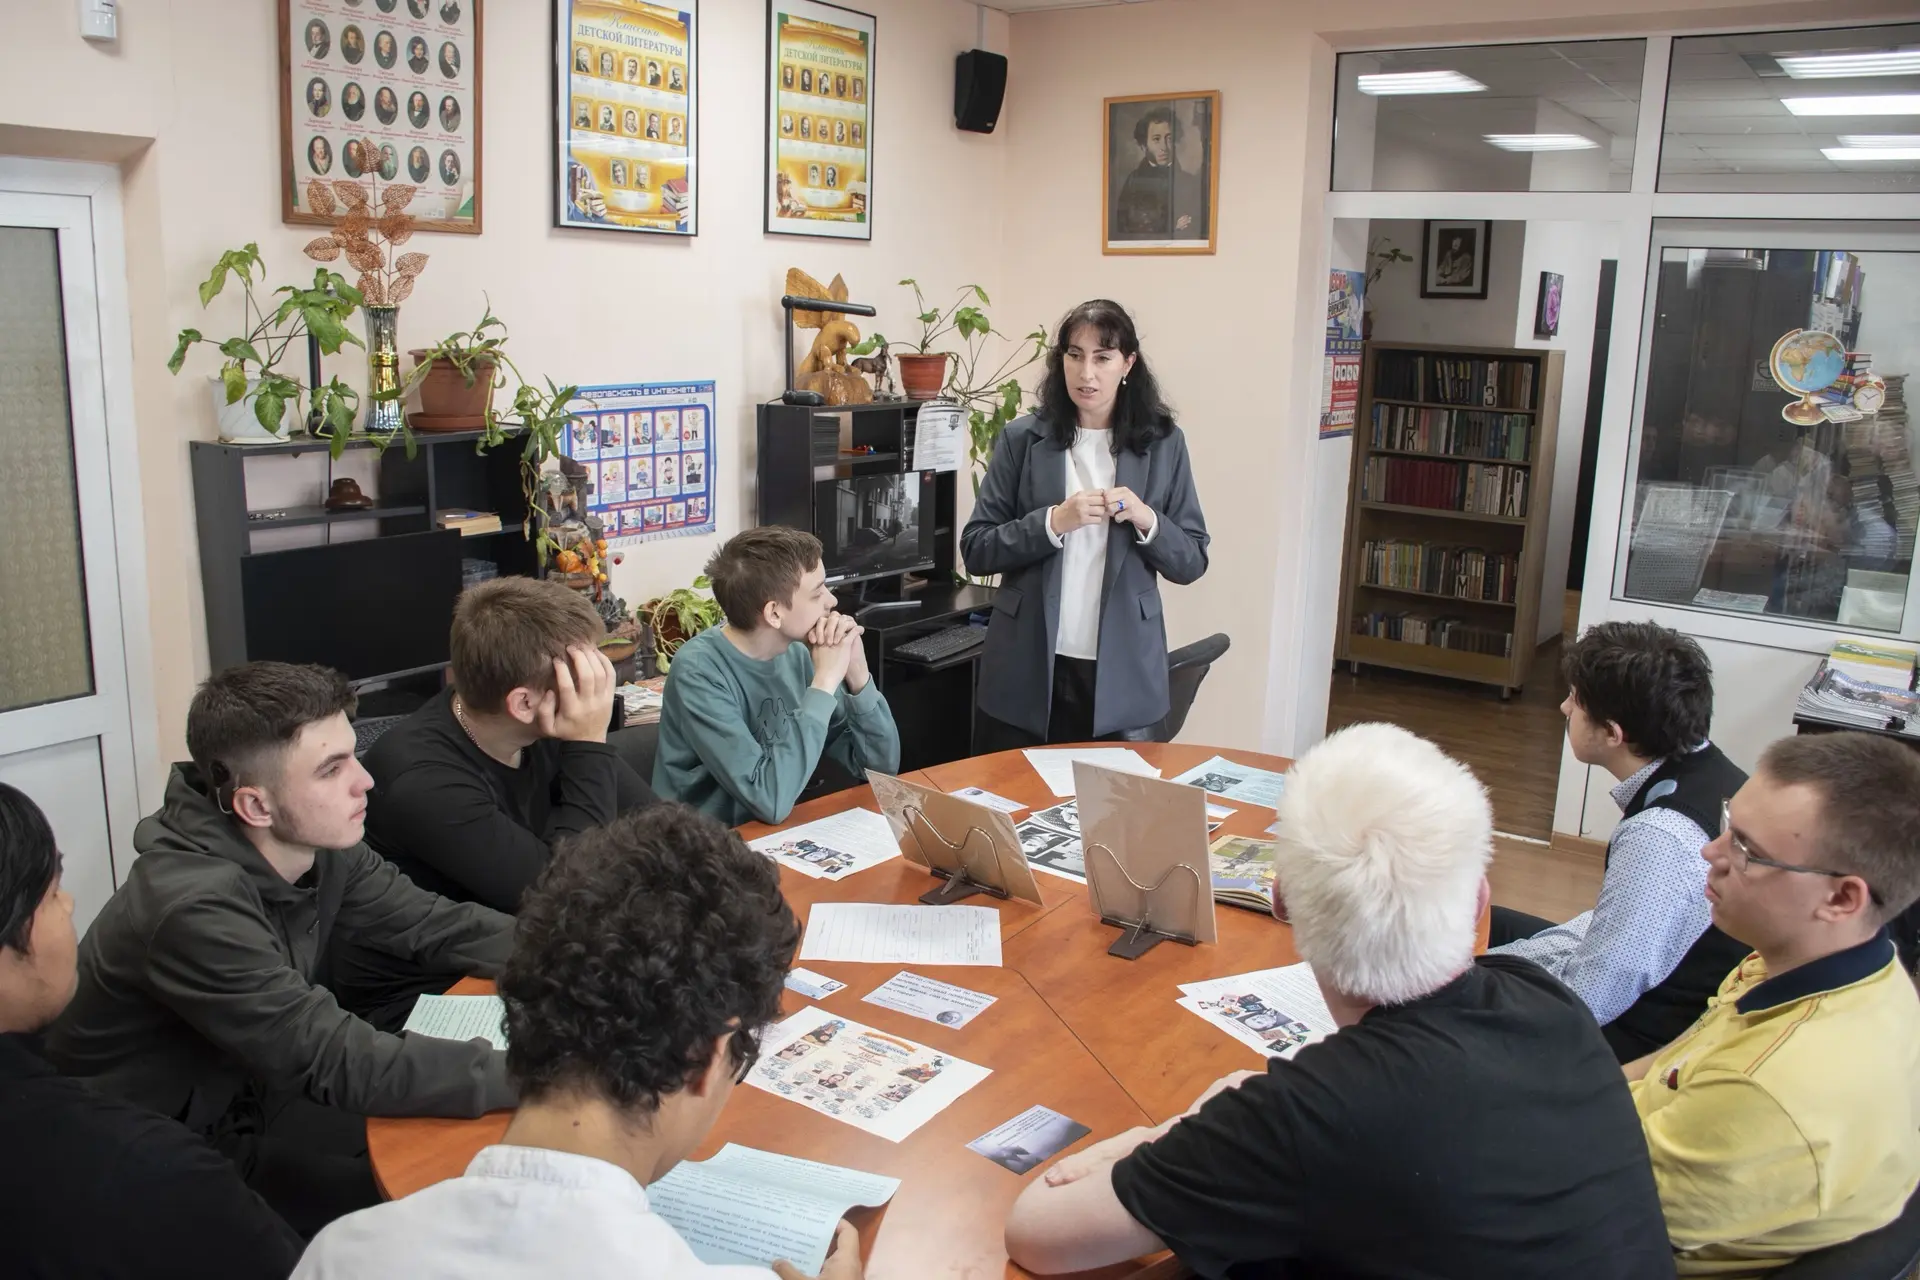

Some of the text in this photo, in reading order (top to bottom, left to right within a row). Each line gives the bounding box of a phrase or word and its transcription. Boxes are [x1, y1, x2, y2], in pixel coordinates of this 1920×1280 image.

[577, 24, 683, 57] ДЕТСКОЙ ЛИТЕРАТУРЫ
[784, 48, 863, 72] ДЕТСКОЙ ЛИТЕРАТУРЫ
